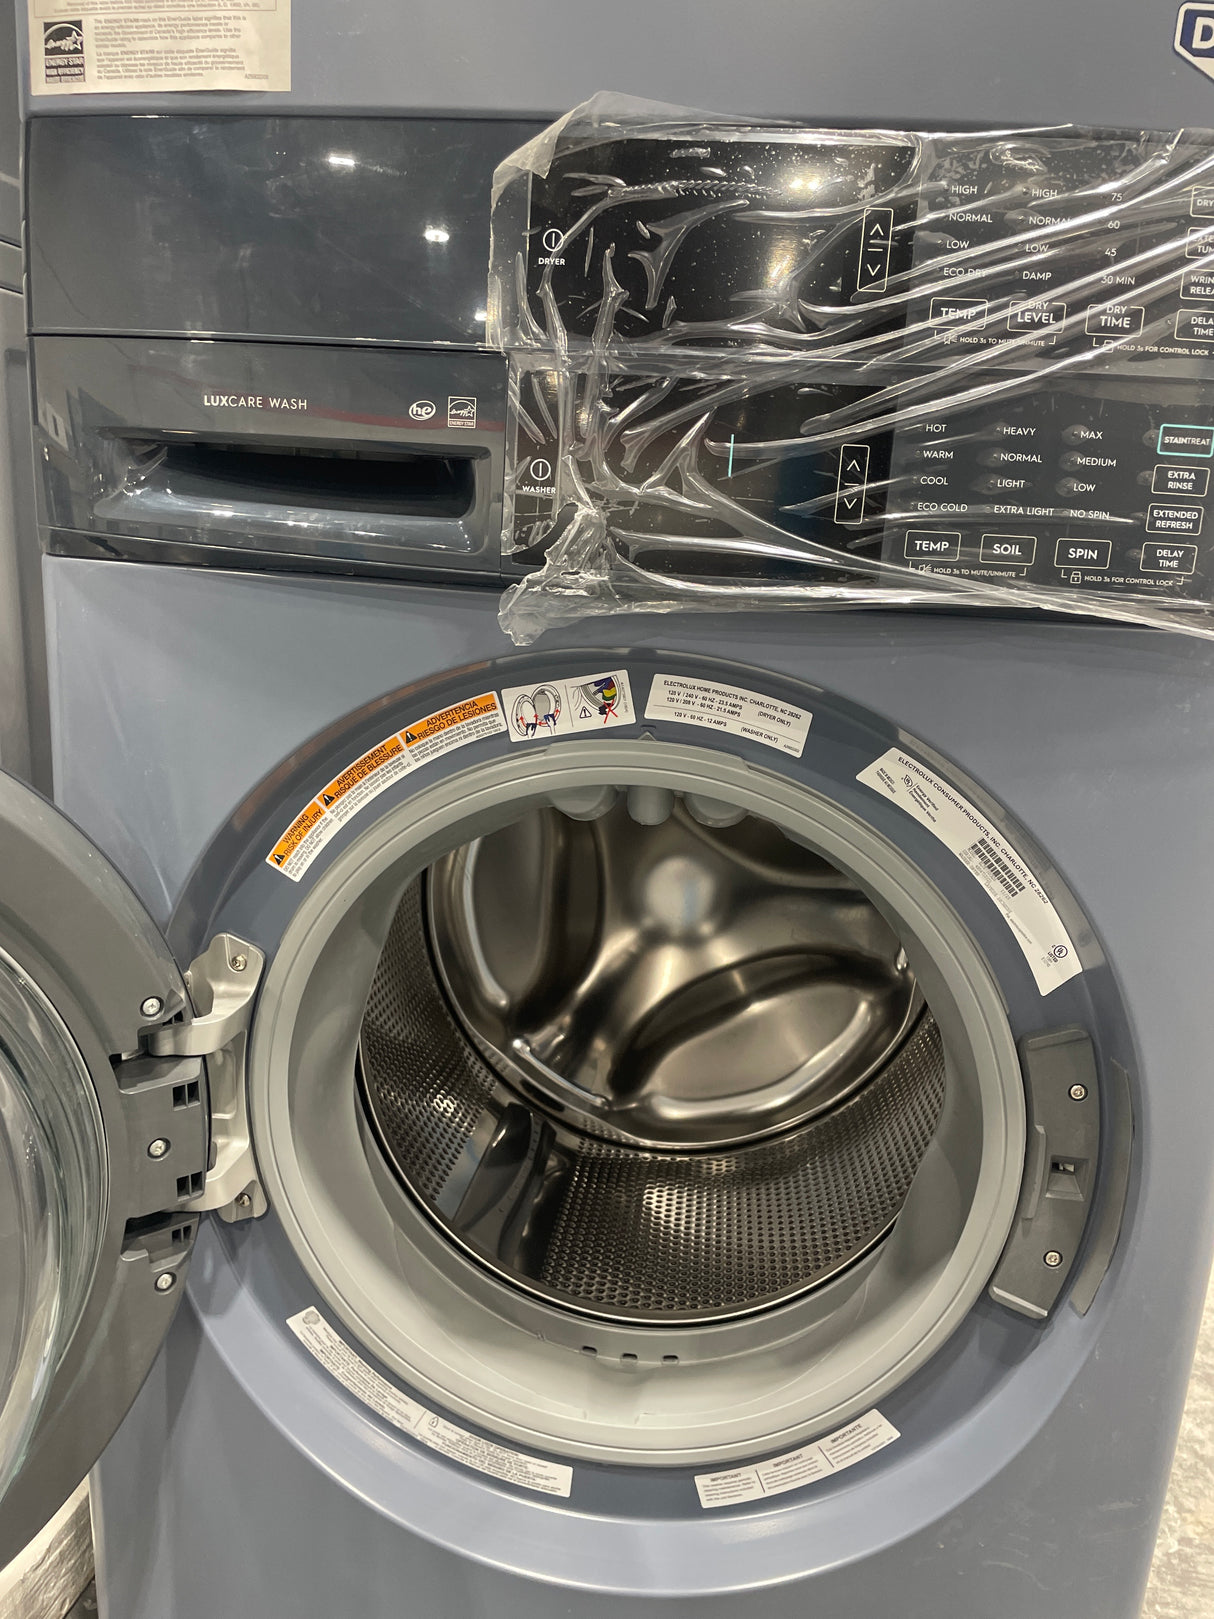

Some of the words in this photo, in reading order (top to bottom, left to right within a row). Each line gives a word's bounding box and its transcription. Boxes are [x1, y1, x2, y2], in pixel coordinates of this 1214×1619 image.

[951, 185, 978, 195] HIGH
[1031, 188, 1058, 198] HIGH
[1111, 192, 1123, 202] 75
[949, 213, 993, 223] NORMAL
[1107, 220, 1121, 230] 60
[946, 240, 970, 249] LOW
[1025, 243, 1049, 253] LOW
[1104, 248, 1118, 257] 45
[537, 257, 566, 266] DRYER
[943, 267, 965, 277] ECO
[1022, 271, 1052, 281] DAMP
[1115, 276, 1136, 286] MIN
[940, 307, 977, 320] TEMP
[1106, 305, 1128, 315] DRY
[1017, 311, 1057, 324] LEVEL
[1100, 316, 1132, 328] TIME
[1160, 347, 1191, 355] CONTROL
[1191, 348, 1211, 356] LOCK
[203, 394, 264, 409] LUXCARE
[269, 397, 308, 410] WASH
[925, 424, 947, 433] HOT
[1003, 427, 1036, 436] HEAVY
[1080, 431, 1104, 440] MAX
[1164, 436, 1211, 446] STAINTREAT
[923, 450, 954, 459] WARM
[1000, 453, 1042, 463] NORMAL
[1077, 457, 1117, 467] MEDIUM
[1167, 470, 1196, 481] EXTRA
[920, 476, 949, 486] COOL
[997, 479, 1026, 489] LIGHT
[1167, 481, 1193, 491] RINSE
[522, 485, 557, 495] WASHER
[1073, 483, 1096, 492] LOW
[917, 502, 938, 511] ECO
[940, 503, 968, 512] COLD
[993, 505, 1024, 515] EXTRA
[1026, 506, 1055, 516] LIGHT
[1069, 509, 1087, 518] NO
[1088, 510, 1111, 520] SPIN
[1153, 509, 1199, 520] EXTENDED
[1155, 520, 1193, 530] REFRESH
[914, 540, 950, 552] TEMP
[992, 543, 1022, 555] SOIL
[1068, 547, 1099, 560] SPIN
[1156, 549, 1185, 558] DELAY
[1158, 559, 1180, 568] TIME
[971, 570, 1017, 578] MUTE/UNMUTE
[1084, 575, 1102, 583] HOLD
[1125, 577, 1155, 586] CONTROL
[1156, 578, 1175, 587] LOCK
[664, 679, 697, 691] ELECTROLUX
[697, 685, 712, 694] HOME
[712, 689, 739, 701] PRODUCTS
[780, 707, 788, 715] NC
[729, 702, 743, 710] AMPS
[426, 700, 479, 727] ADVERTENCIA
[727, 709, 741, 718] AMPS
[416, 720, 447, 740] RIESGO
[446, 715, 459, 728] DE
[458, 702, 497, 723] LESIONES
[713, 719, 727, 727] AMPS
[741, 726, 764, 738] (WASHER
[336, 744, 388, 787] AVERTISSEMENT
[334, 777, 360, 799] RISQUE
[356, 767, 370, 780] DE
[366, 744, 404, 772] BLESSURE
[898, 756, 934, 785] ELECTROLUX
[933, 782, 964, 811] CONSUMER
[962, 808, 990, 839] PRODUCTS,
[1000, 848, 1029, 880] CHARLOTTE,
[1027, 878, 1037, 889] NC
[282, 813, 310, 845] WARNING
[283, 840, 299, 857] RISK
[294, 830, 305, 842] OF
[302, 808, 324, 833] INJURY
